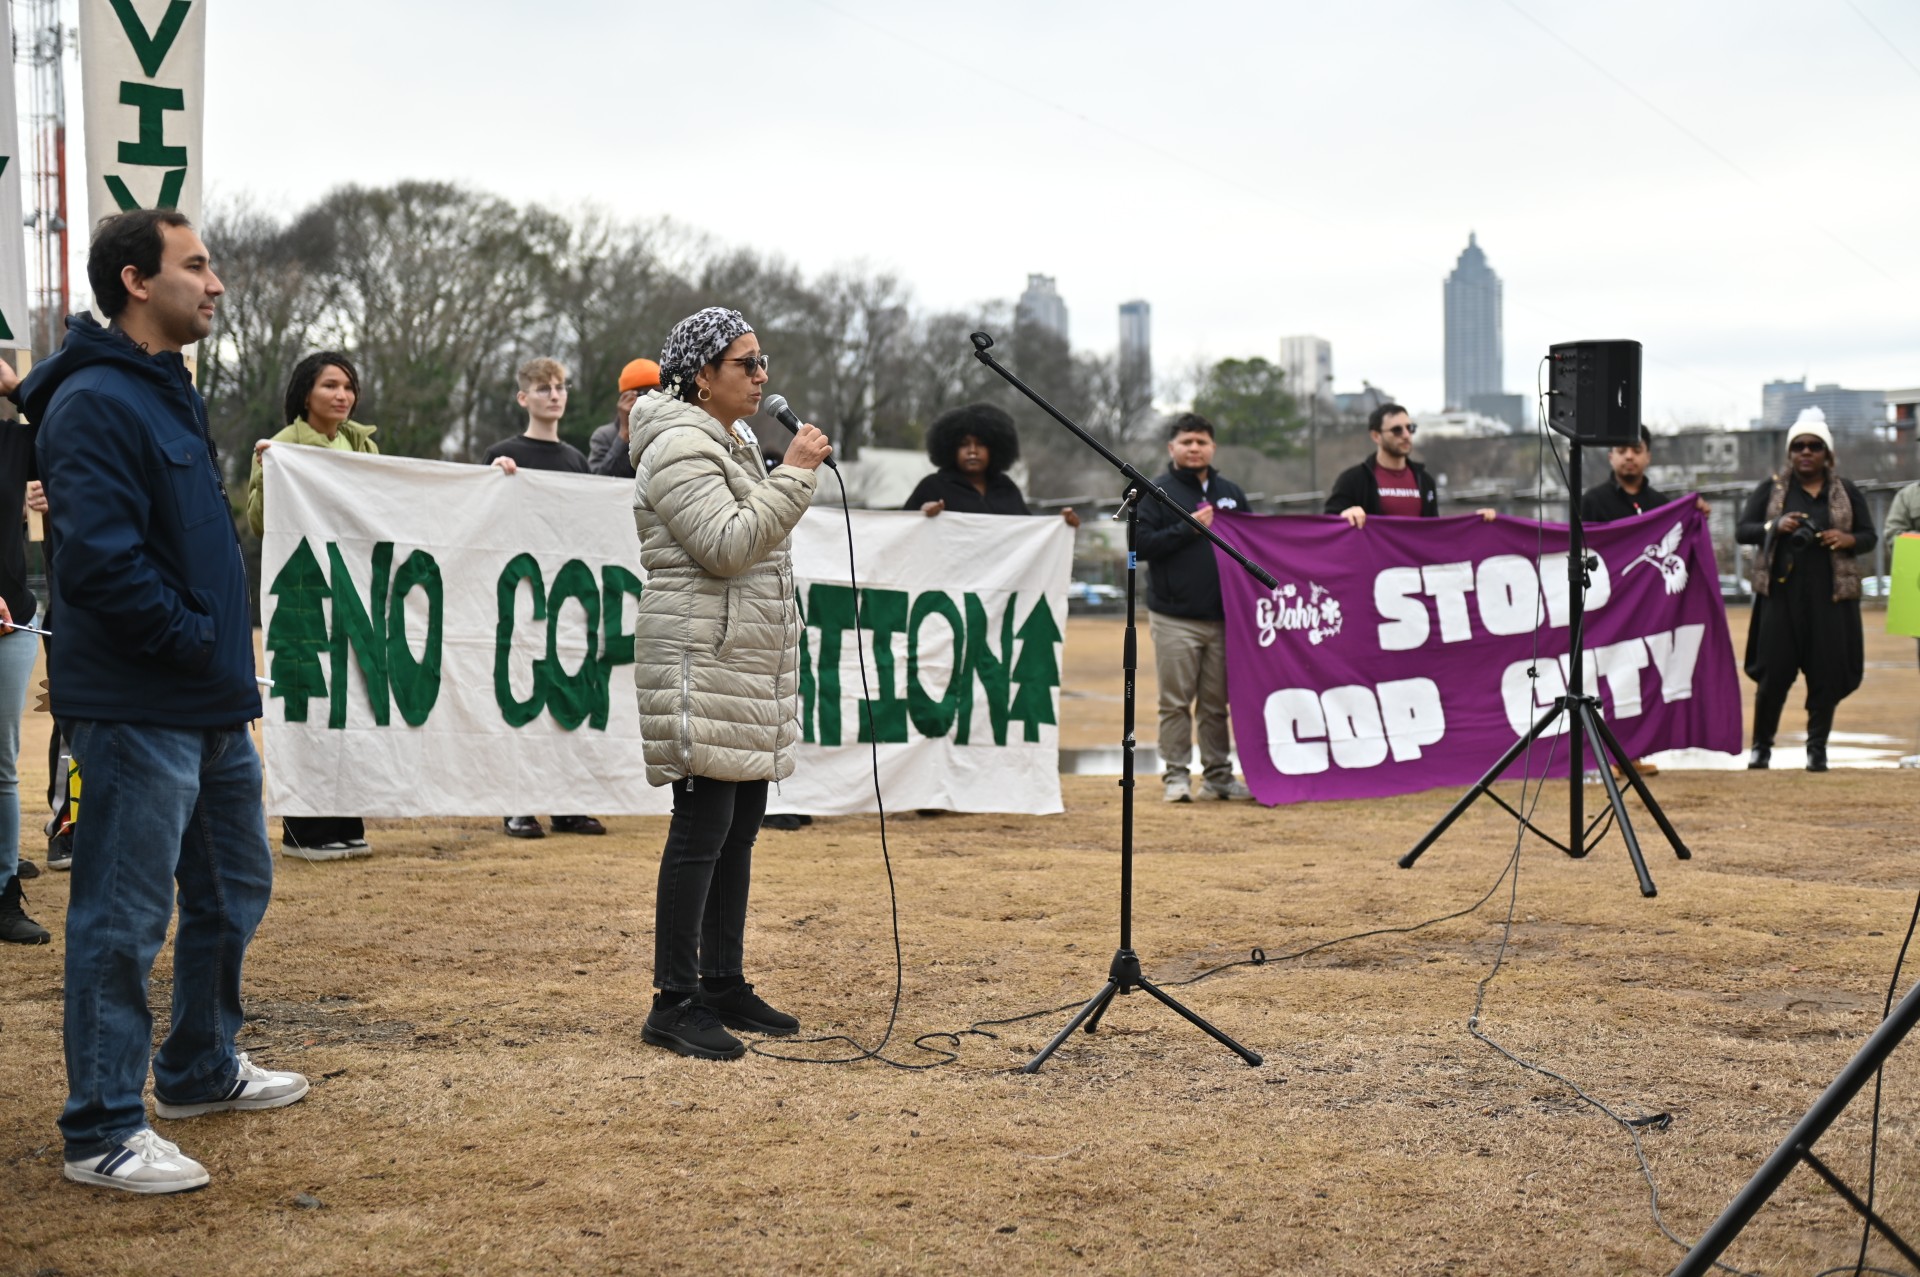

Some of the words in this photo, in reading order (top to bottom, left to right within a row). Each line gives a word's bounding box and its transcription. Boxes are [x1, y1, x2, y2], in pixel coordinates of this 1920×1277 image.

[326, 540, 443, 729] NO
[1374, 549, 1611, 651] STOP
[1263, 677, 1446, 776] COP
[1500, 623, 1706, 739] CITY
